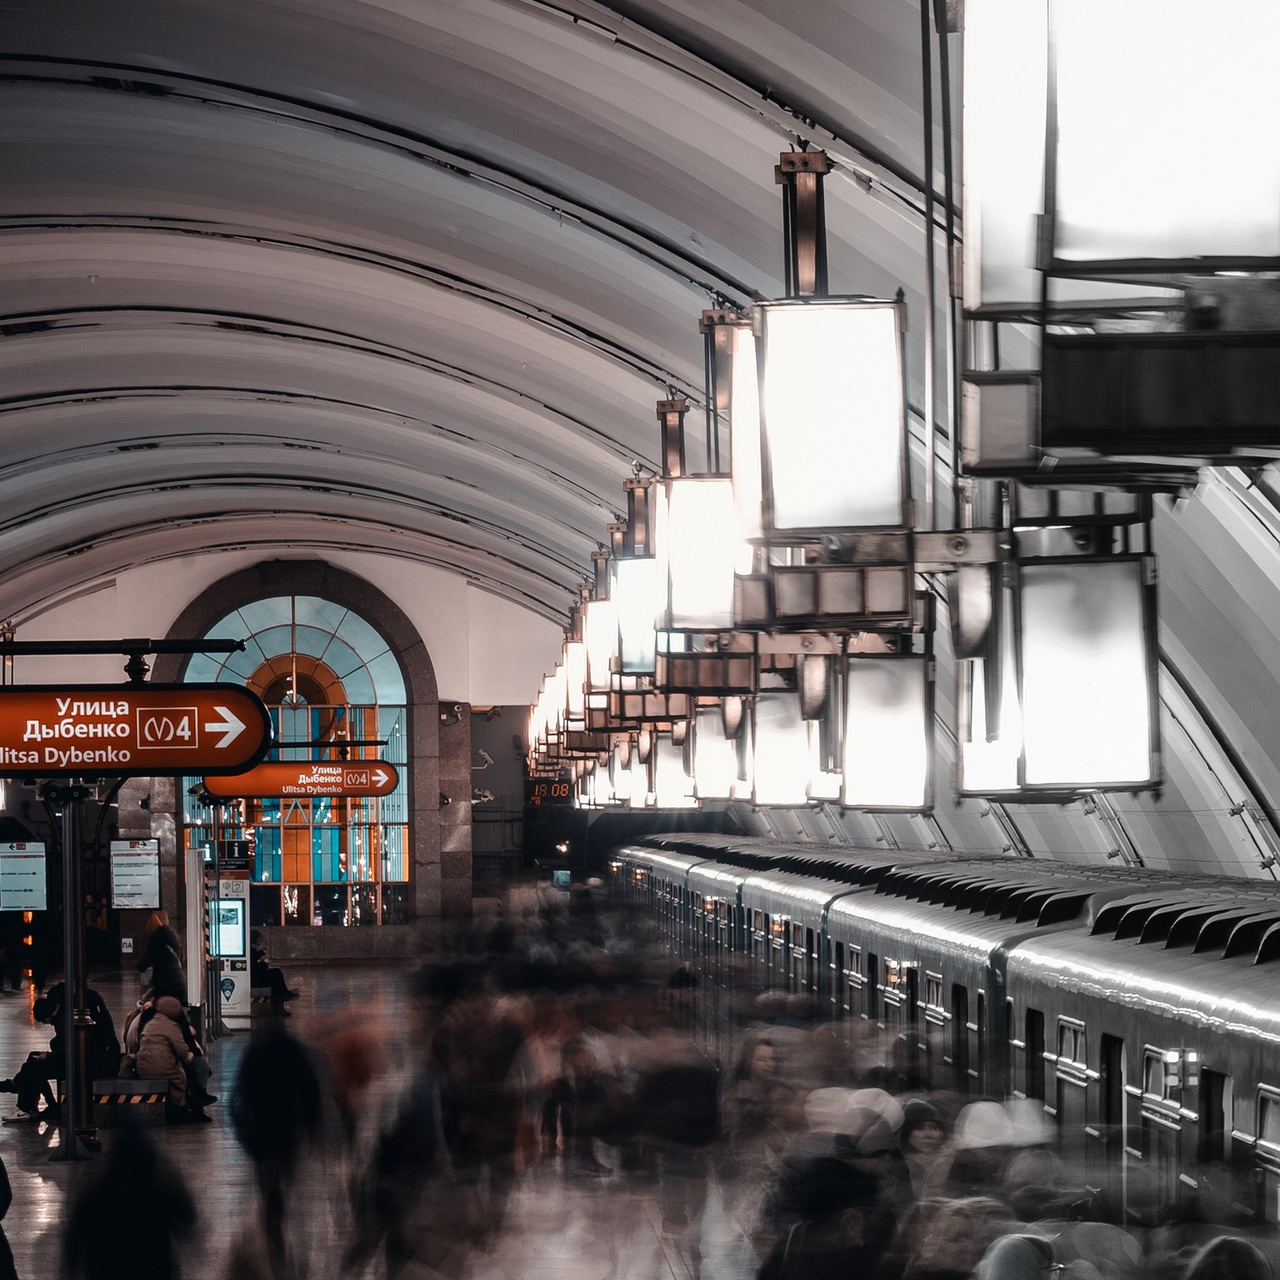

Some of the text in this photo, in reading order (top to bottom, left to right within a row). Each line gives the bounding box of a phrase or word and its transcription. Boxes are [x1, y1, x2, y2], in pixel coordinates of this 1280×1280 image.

[56, 698, 129, 718] Улица
[23, 718, 130, 741] Дыбенко
[44, 745, 131, 767] Dybenko
[311, 765, 342, 775] Улица
[298, 774, 342, 784] Дыбенко
[282, 785, 342, 795] Ulitsa Dybenko
